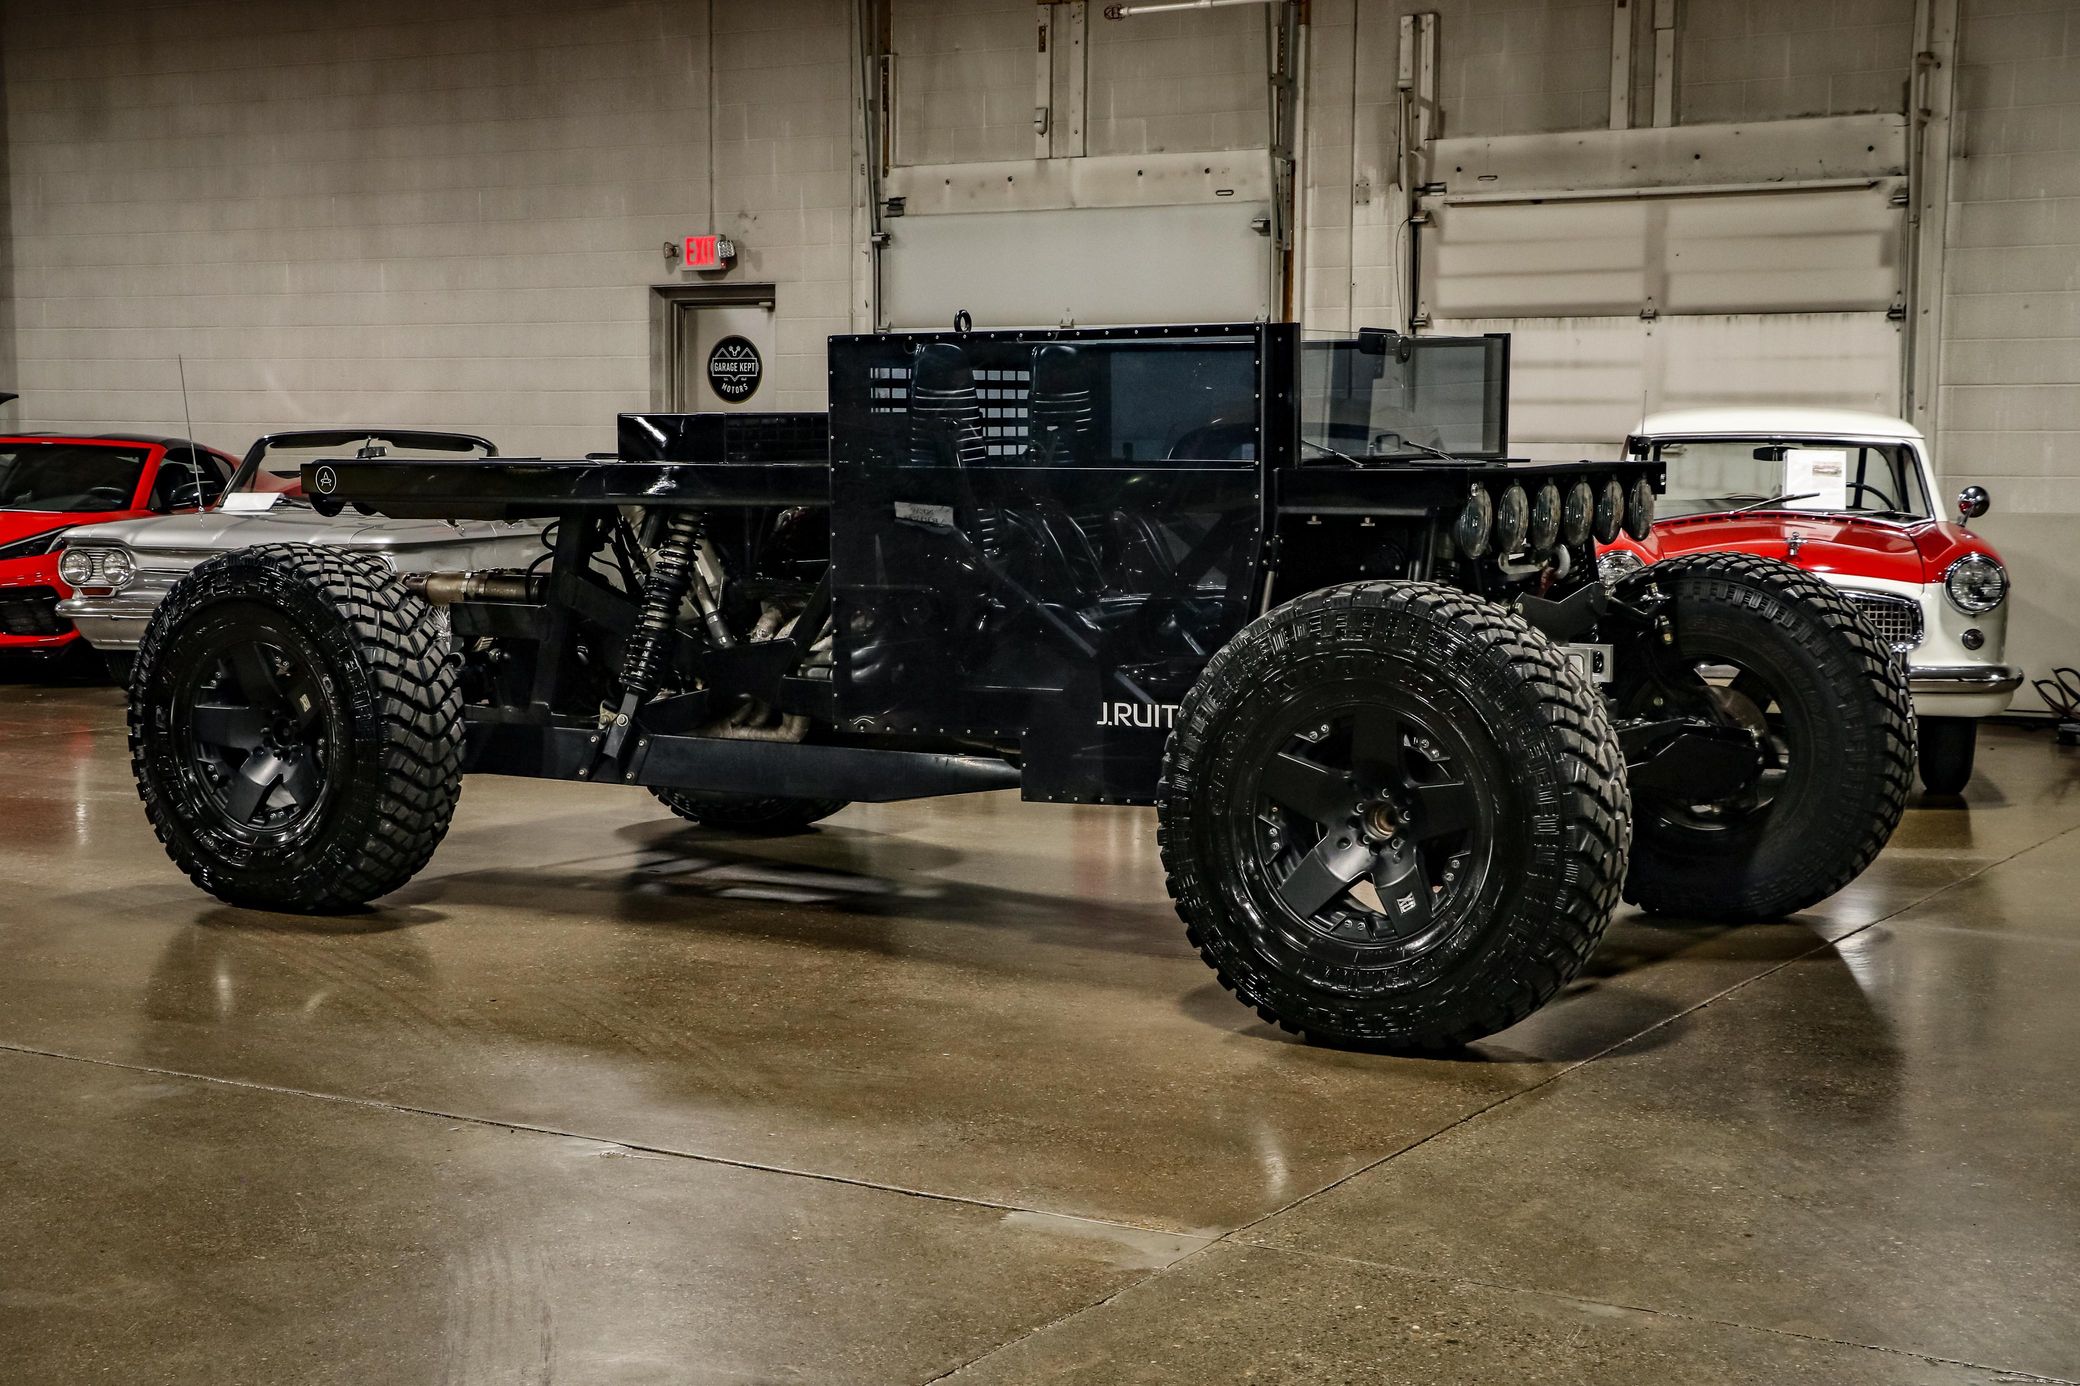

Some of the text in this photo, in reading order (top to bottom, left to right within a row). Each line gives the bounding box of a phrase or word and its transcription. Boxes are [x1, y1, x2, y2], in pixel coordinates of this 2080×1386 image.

[686, 235, 717, 266] EXIT
[714, 362, 756, 372] GARAGE KEPT
[721, 382, 749, 394] MOTORS
